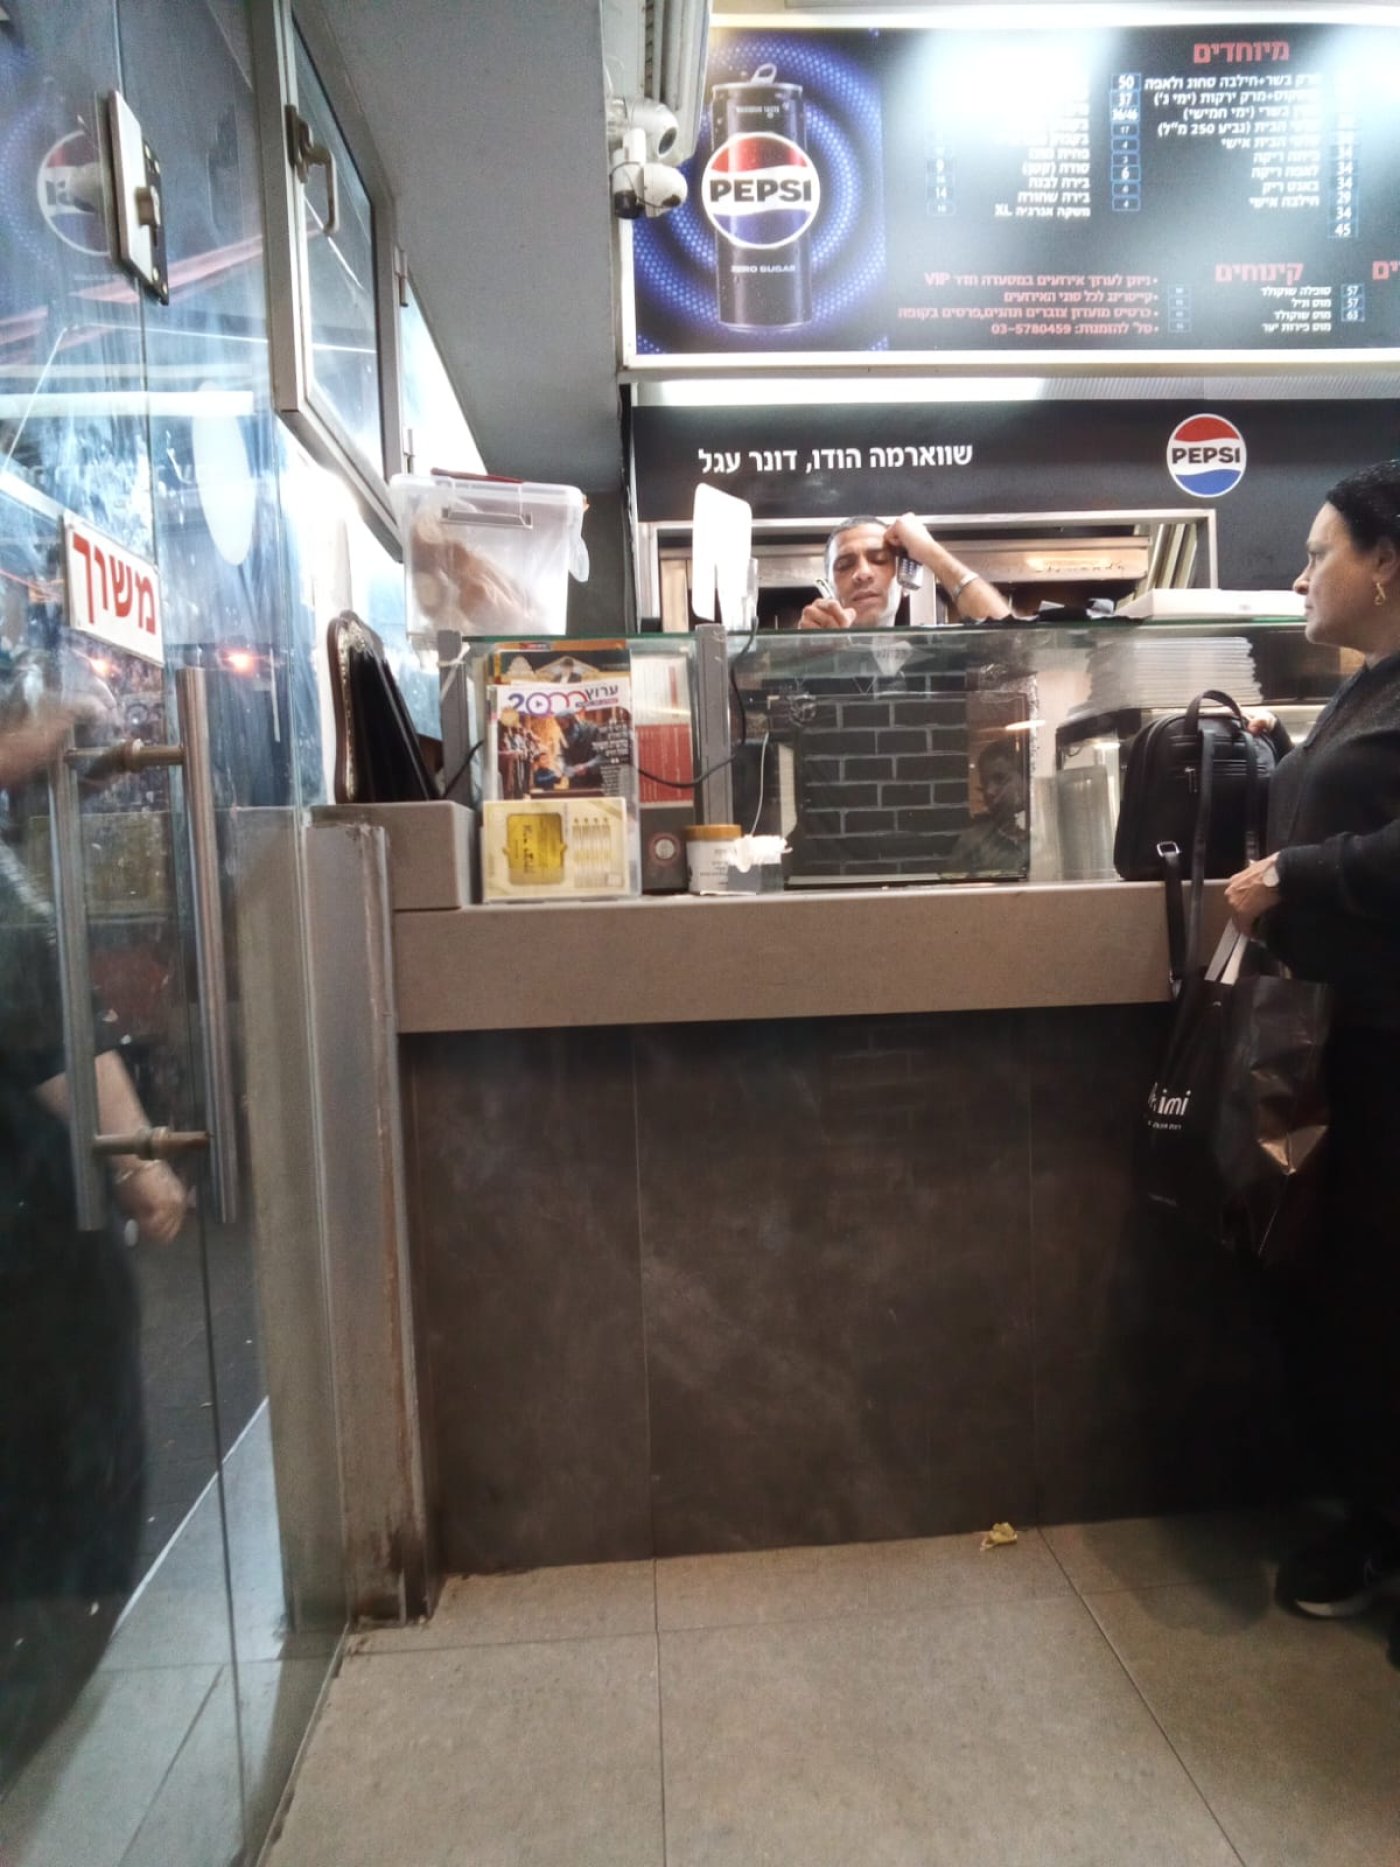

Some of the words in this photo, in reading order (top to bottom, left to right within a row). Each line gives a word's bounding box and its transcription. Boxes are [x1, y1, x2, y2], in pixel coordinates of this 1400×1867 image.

[1193, 42, 1290, 64] מיוחדים
[1118, 75, 1135, 90] 50
[1200, 92, 1237, 105] ירקות
[1190, 123, 1215, 135] 250
[709, 179, 812, 203] PEPSI
[994, 203, 1012, 217] XL
[1336, 206, 1352, 220] 34
[1335, 223, 1351, 237] 45
[731, 264, 758, 273] ZERO
[759, 264, 796, 273] SUGAR
[1214, 262, 1304, 285] קינוחים
[924, 272, 950, 286] VIP
[1036, 274, 1085, 286] אירועים
[1003, 291, 1056, 302] האירועים
[1083, 289, 1104, 302] לכל
[1260, 286, 1297, 299] שוקולד
[1347, 285, 1359, 296] 57
[1106, 291, 1153, 304] קייטרינג
[1312, 298, 1332, 308] מוס
[1347, 298, 1359, 308] 57
[1070, 307, 1110, 320] מועדון
[1113, 307, 1152, 318] כרטיס
[1273, 309, 1310, 322] שוקולד
[1312, 310, 1332, 321] מוס
[990, 323, 1071, 335] 03-5780459
[1312, 322, 1332, 333] מוס
[697, 448, 741, 474] עגל
[748, 449, 798, 473] דונר
[806, 446, 862, 474] הודו,
[869, 444, 974, 468] שווארמה
[1171, 446, 1241, 465] PEPSI
[72, 531, 156, 635] משוך
[585, 684, 618, 701] ערוץ
